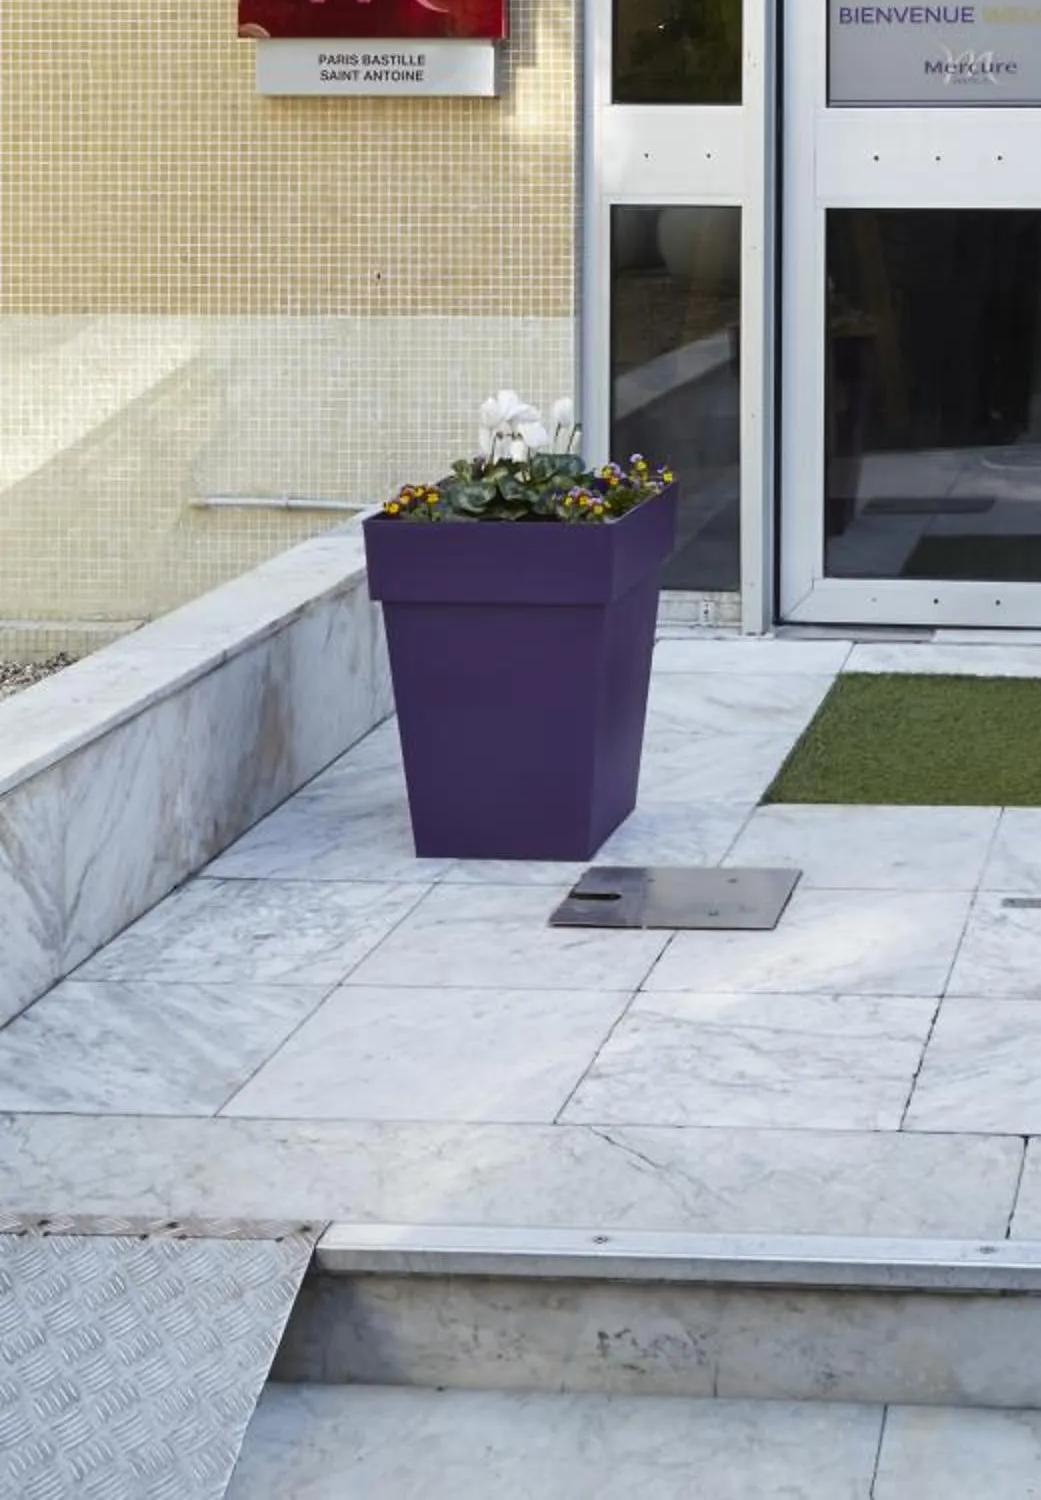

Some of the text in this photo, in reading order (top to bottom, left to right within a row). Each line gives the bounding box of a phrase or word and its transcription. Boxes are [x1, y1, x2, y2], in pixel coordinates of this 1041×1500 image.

[838, 6, 976, 25] BIENVENUE
[318, 53, 427, 67] PARIS BASTILLE
[924, 59, 1018, 76] Mercure
[320, 69, 425, 82] SAINT ANTOINE
